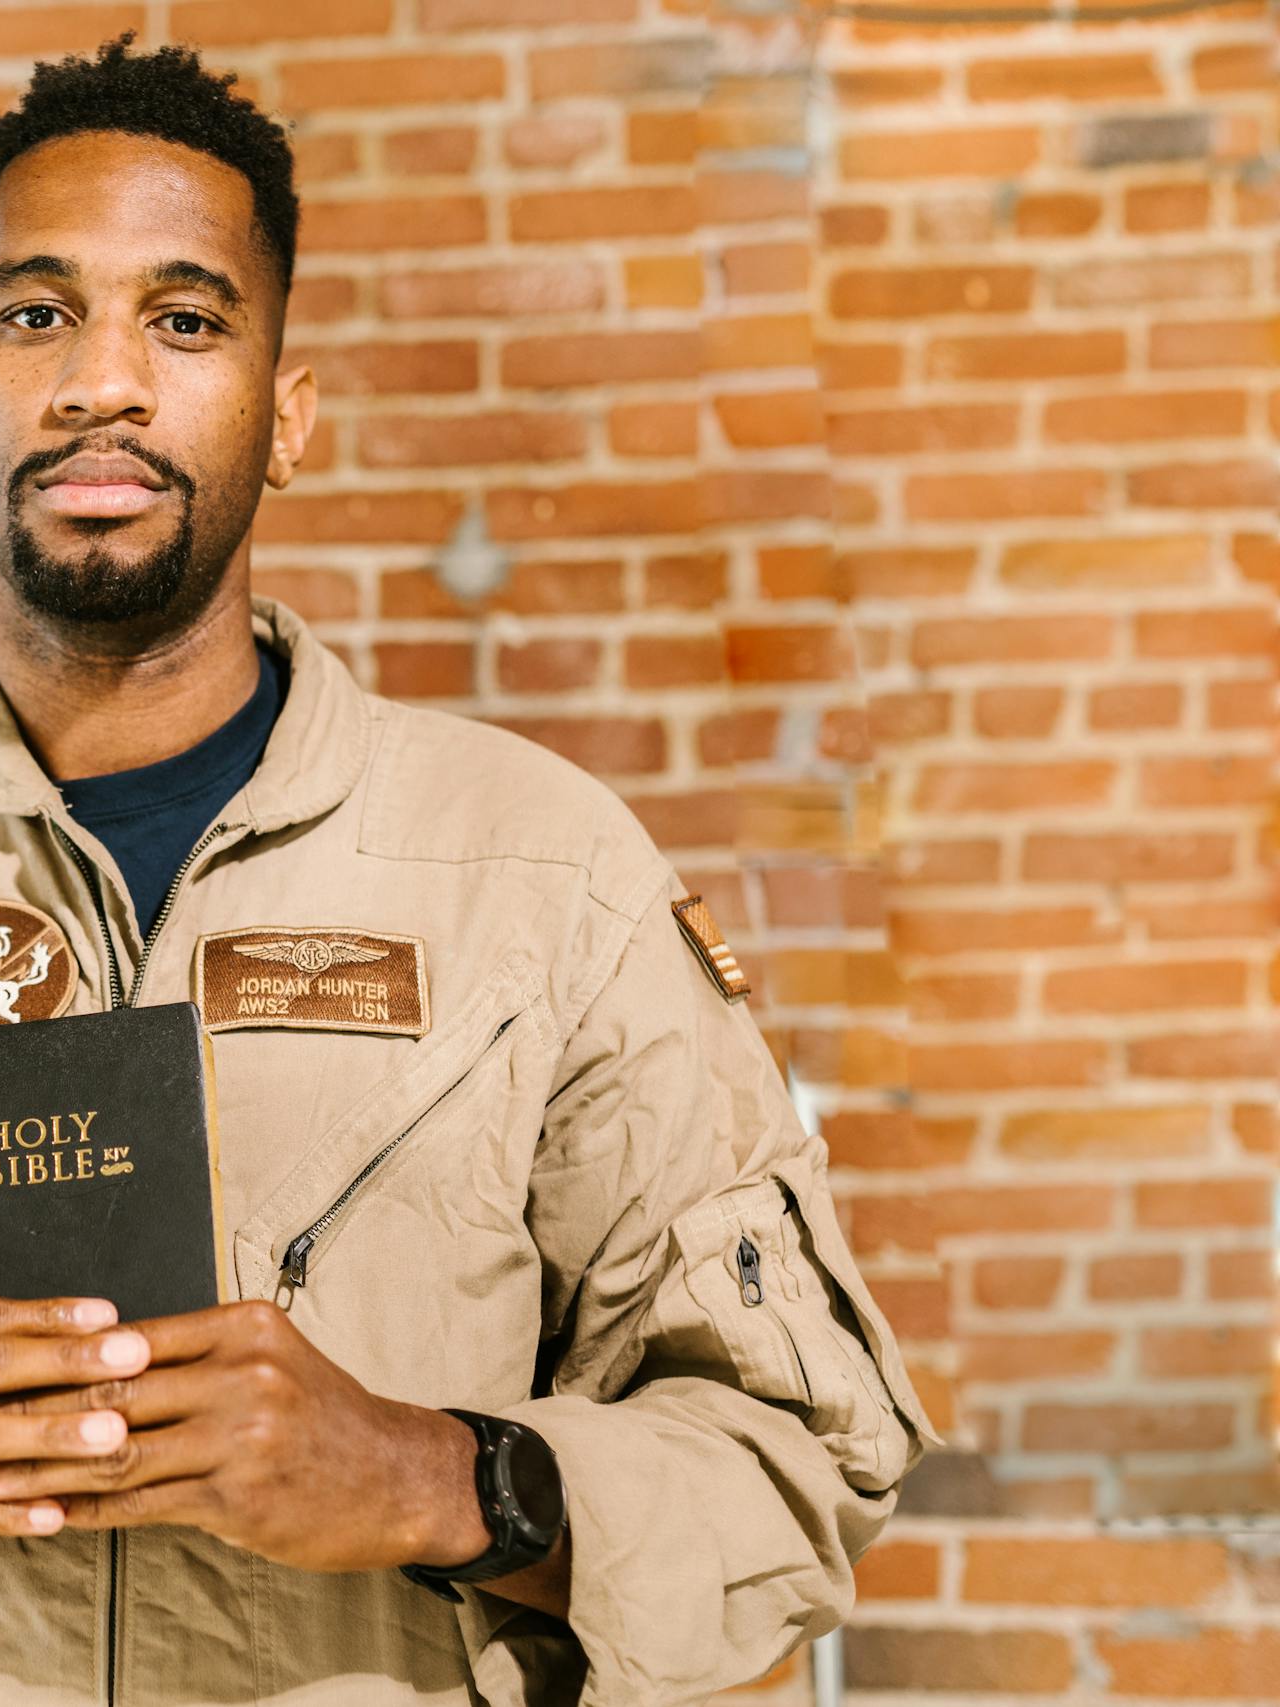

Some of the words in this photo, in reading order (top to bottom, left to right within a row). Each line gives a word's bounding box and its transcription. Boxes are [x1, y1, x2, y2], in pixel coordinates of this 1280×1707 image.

[236, 978, 310, 996] JORDAN
[318, 980, 388, 1000] HUNTER
[237, 998, 290, 1015] AWS2
[352, 1003, 389, 1021] USN
